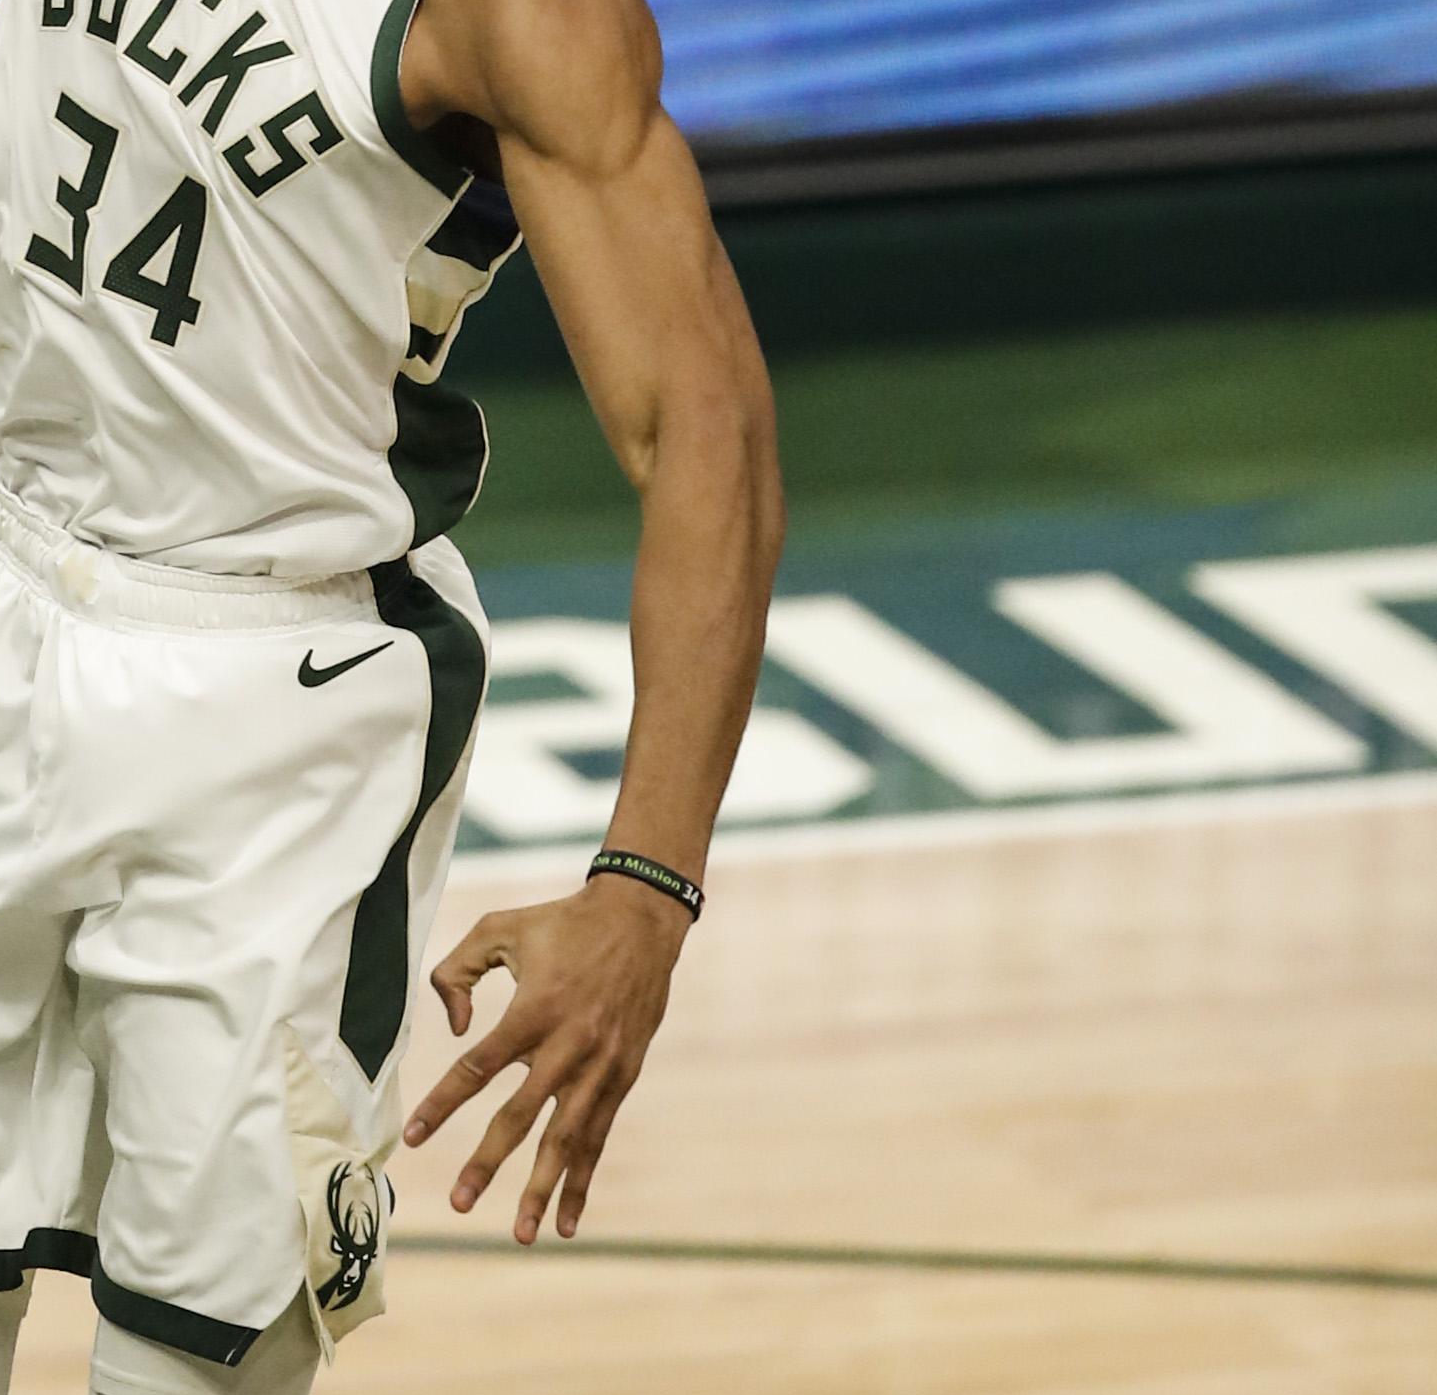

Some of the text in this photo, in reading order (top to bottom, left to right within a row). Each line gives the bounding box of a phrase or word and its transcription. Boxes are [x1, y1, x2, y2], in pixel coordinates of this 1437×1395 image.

[23, 90, 209, 348] 34
[612, 857, 622, 866] a
[625, 856, 681, 891] Mission
[682, 883, 700, 906] 34
